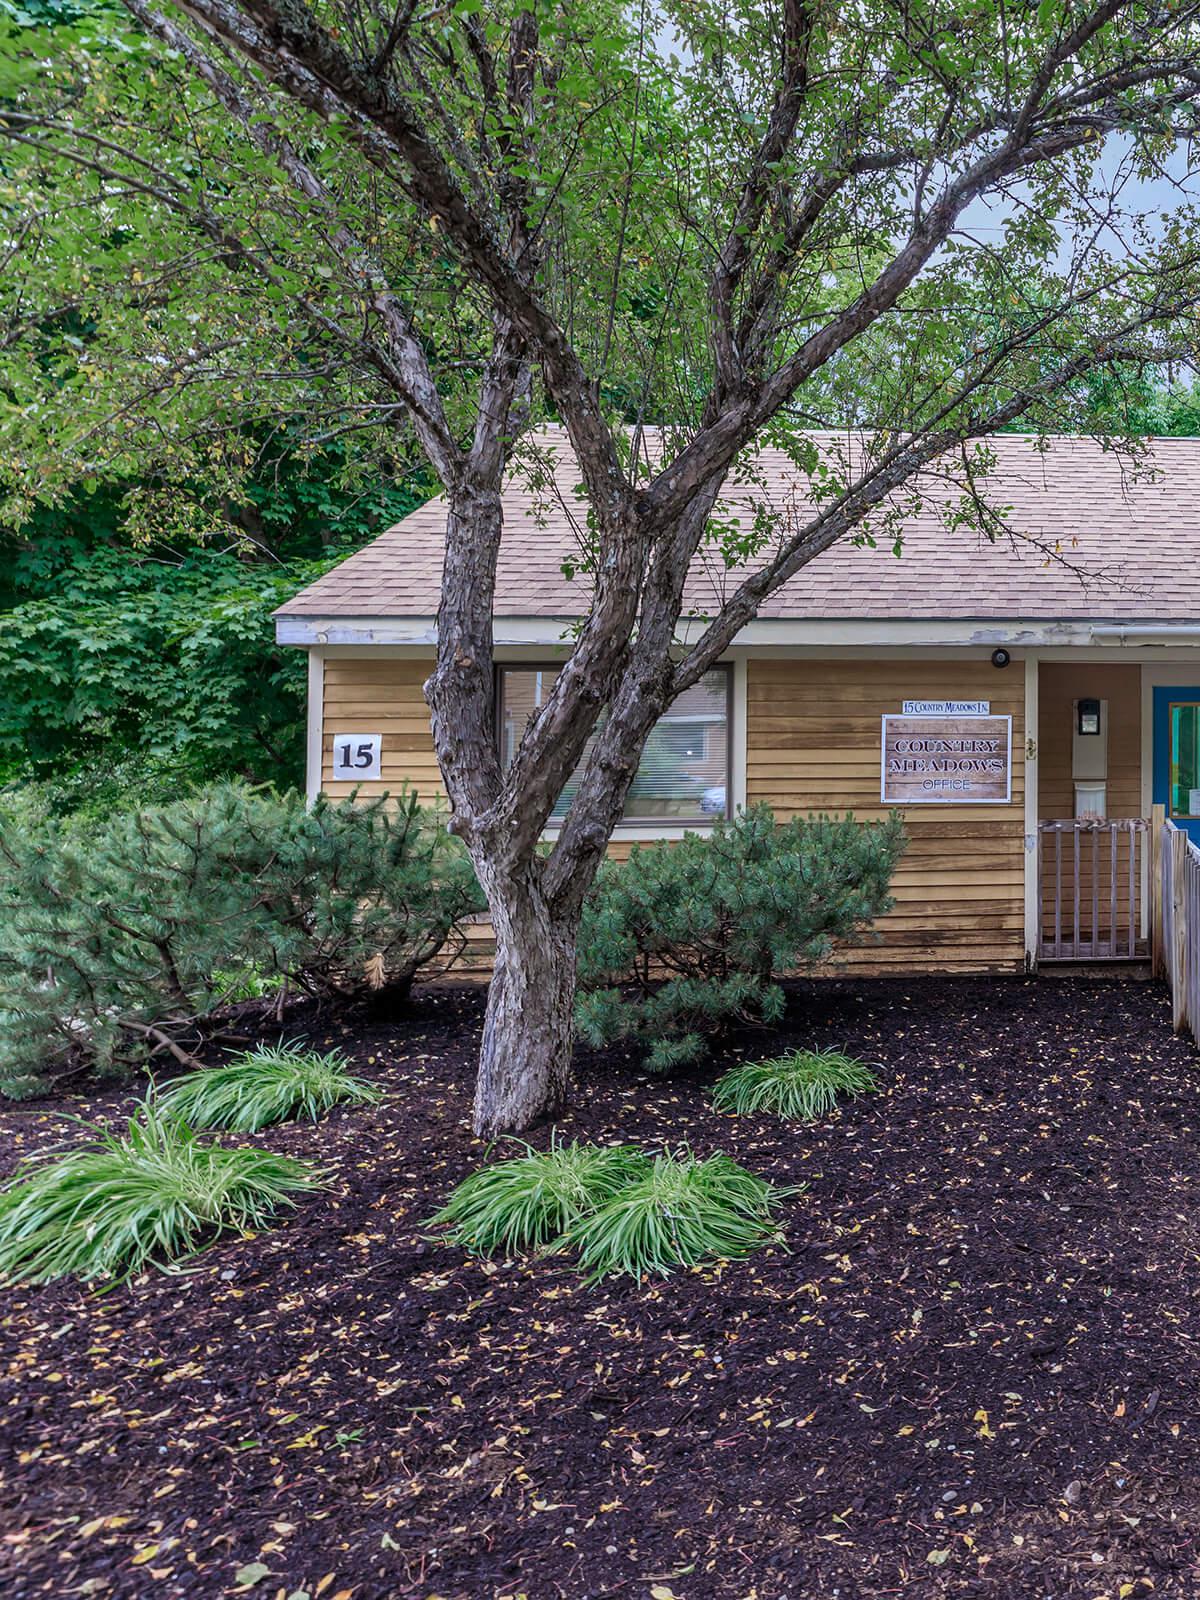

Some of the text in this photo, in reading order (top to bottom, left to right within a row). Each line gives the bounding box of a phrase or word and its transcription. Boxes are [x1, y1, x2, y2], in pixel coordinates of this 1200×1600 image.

[904, 702, 914, 713] 15
[895, 740, 999, 753] COUNTRY
[340, 743, 373, 768] 15
[890, 759, 1004, 772] MEADOWS
[922, 779, 971, 790] OFFICE
